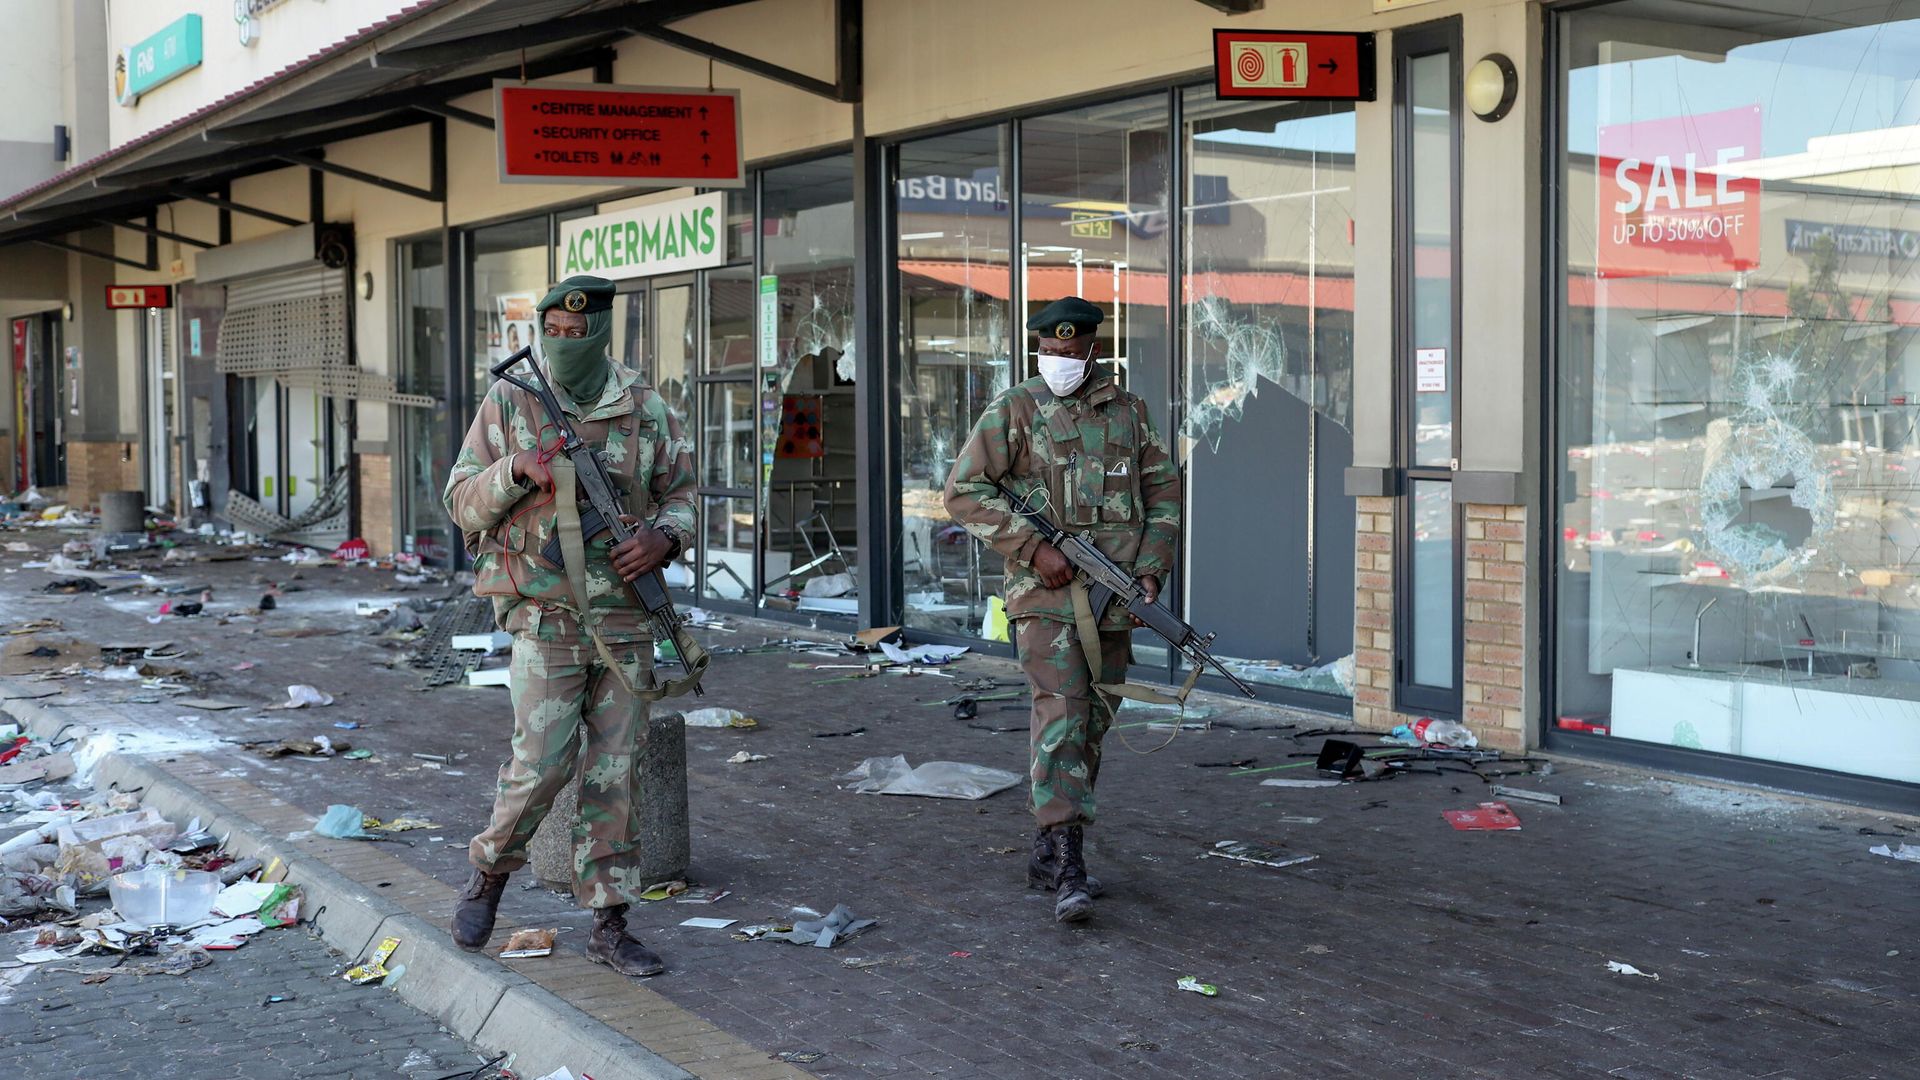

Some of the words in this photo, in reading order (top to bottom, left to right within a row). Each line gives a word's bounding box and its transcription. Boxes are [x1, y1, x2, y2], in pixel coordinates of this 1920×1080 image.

[540, 102, 594, 115] CENTRE
[598, 104, 693, 118] MANAGEMENT
[542, 126, 609, 139] SECURITY
[612, 128, 660, 141] OFFICE
[542, 151, 600, 164] TOILETS
[1614, 145, 1745, 214] SALE
[565, 206, 715, 274] ACKERMANS
[1613, 223, 1637, 245] UP
[1641, 221, 1662, 242] TO
[1668, 218, 1703, 241] 50%
[1708, 214, 1744, 238] OFF
